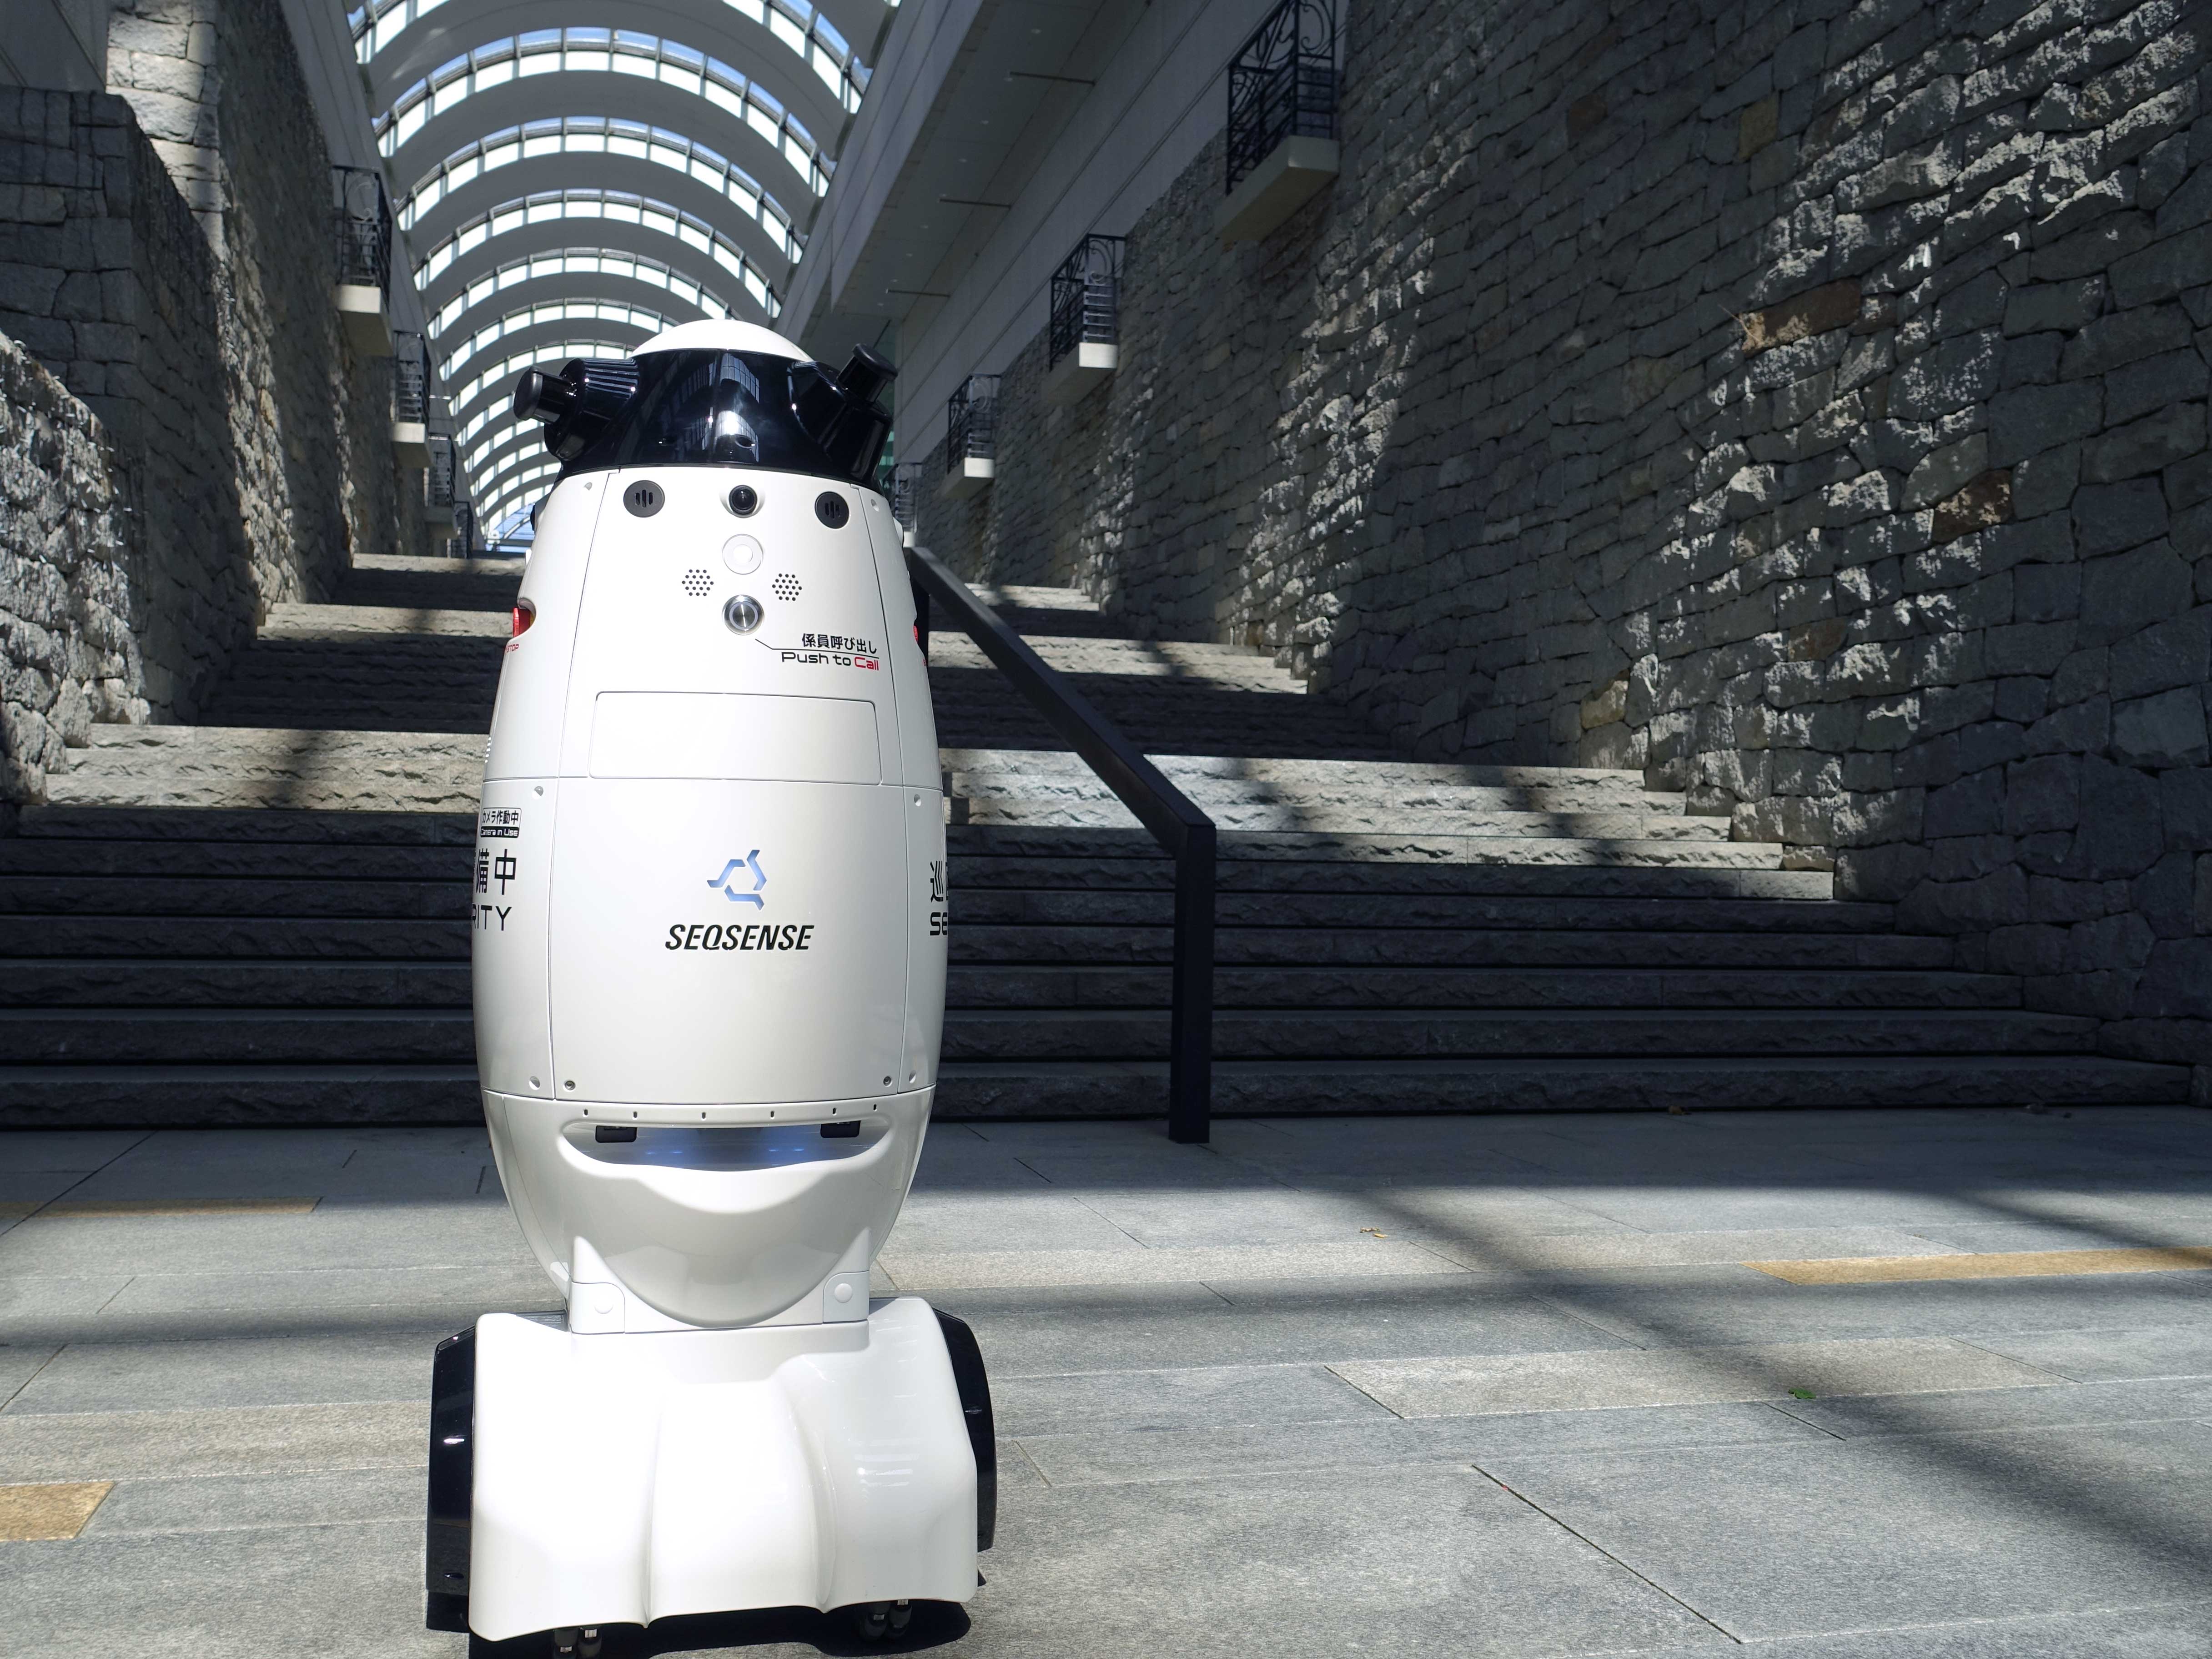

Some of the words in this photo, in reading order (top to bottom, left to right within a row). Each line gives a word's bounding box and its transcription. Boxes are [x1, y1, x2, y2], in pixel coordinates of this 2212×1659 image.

[802, 633, 877, 654] 係員呼び出し
[781, 652, 829, 664] Push
[832, 654, 851, 666] to
[854, 656, 880, 671] Call
[483, 809, 519, 825] カメラ作動中
[474, 848, 517, 895] 備中
[930, 860, 949, 903] 巡
[665, 924, 814, 950] SEQSENSE
